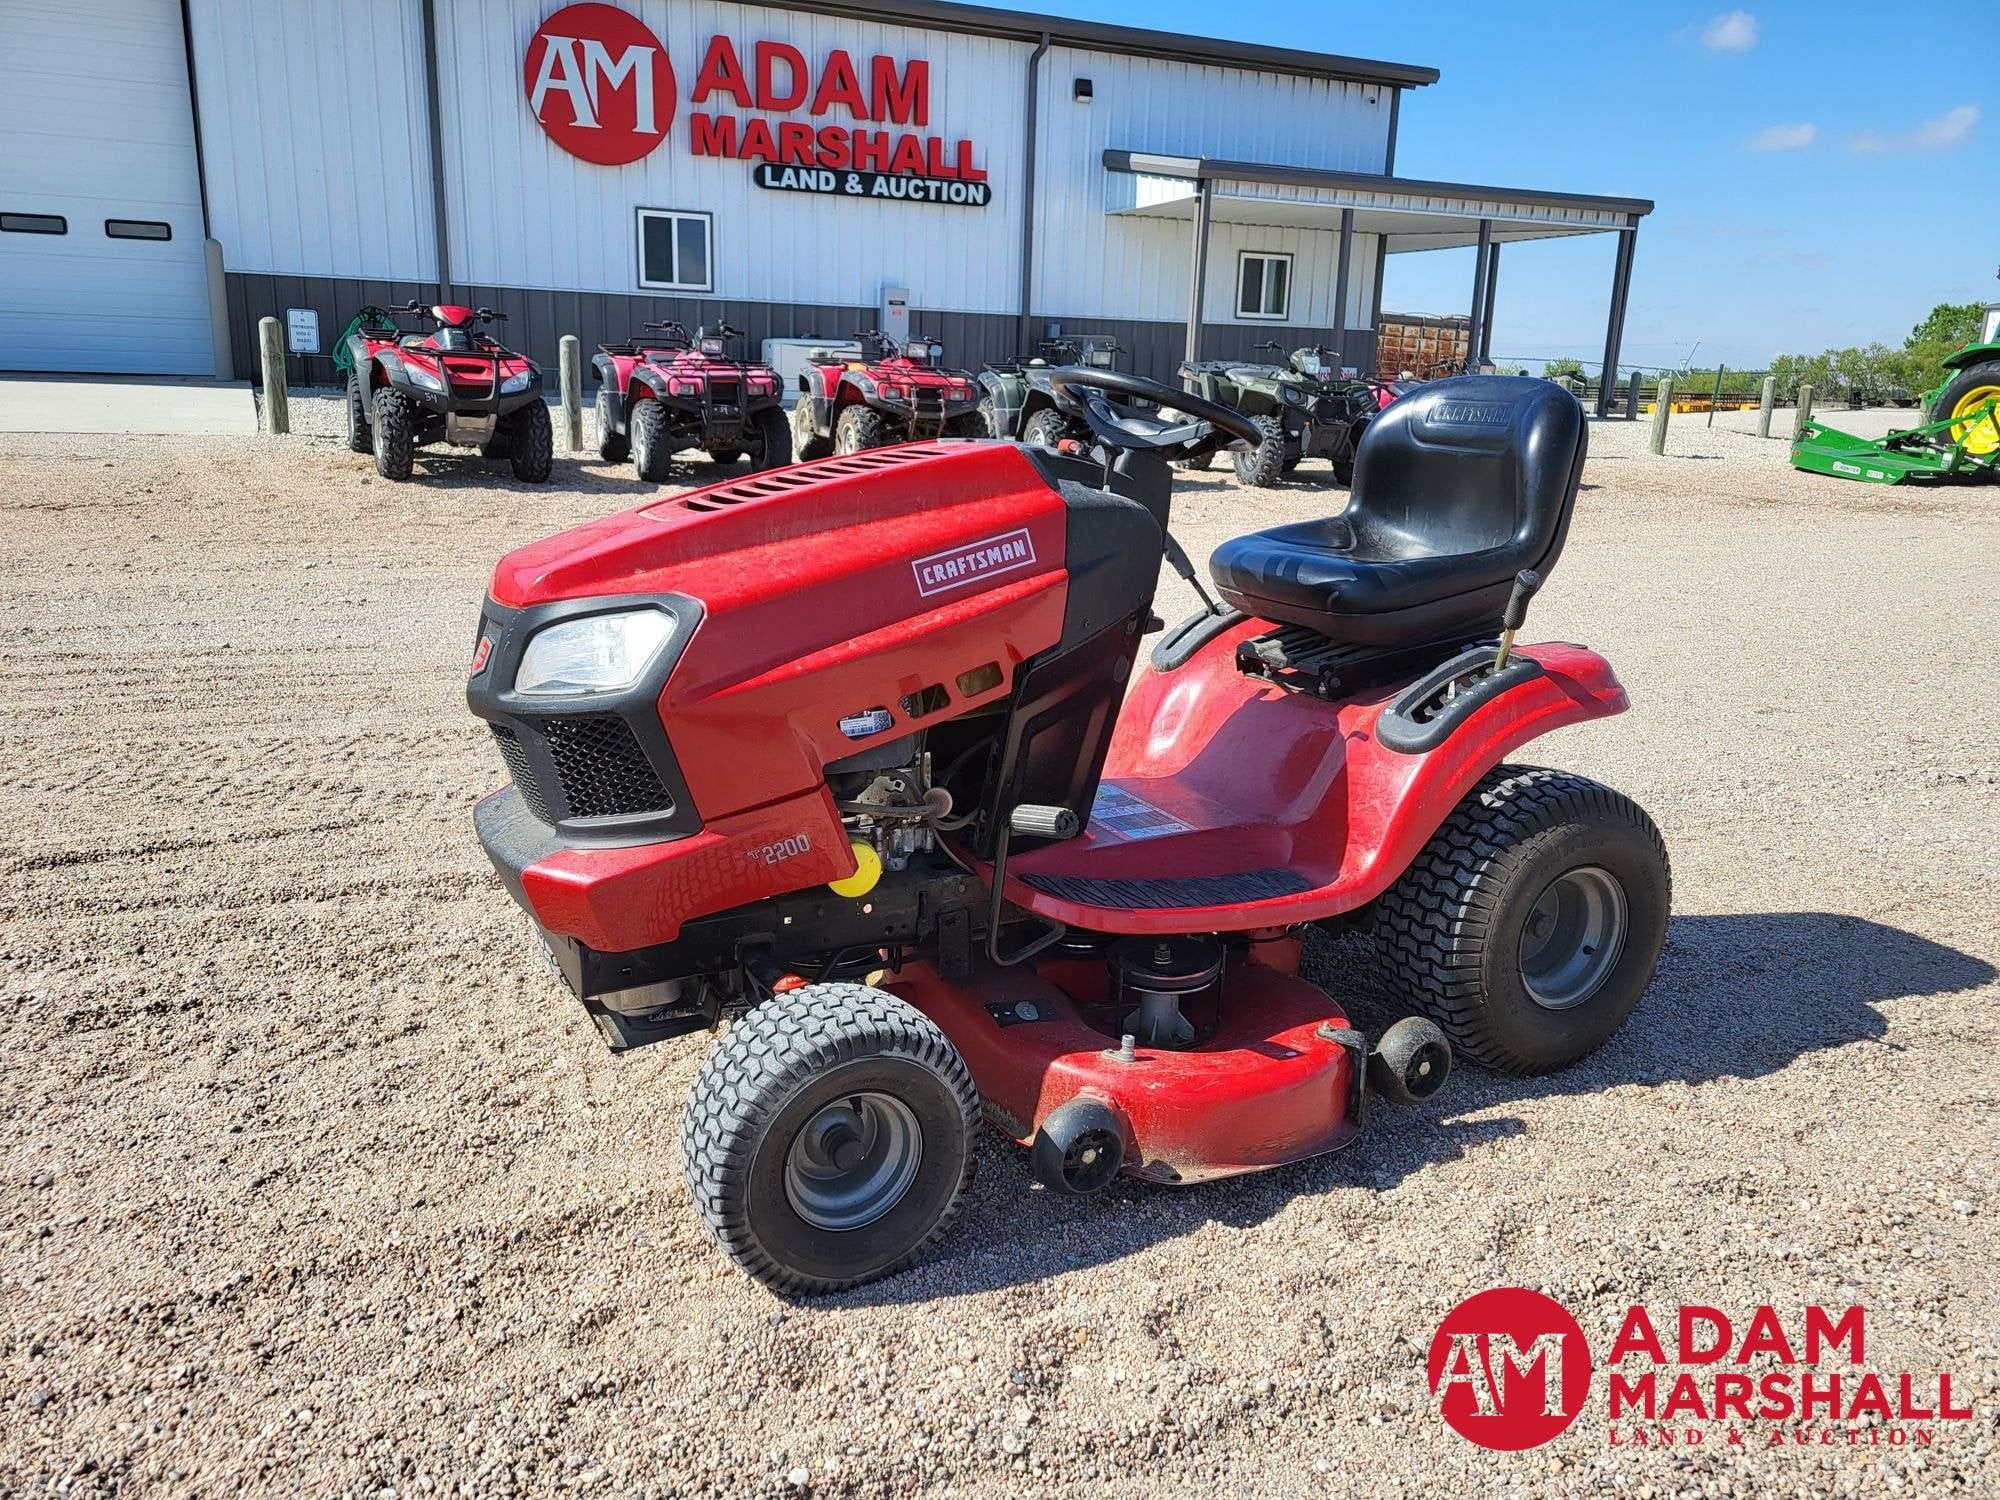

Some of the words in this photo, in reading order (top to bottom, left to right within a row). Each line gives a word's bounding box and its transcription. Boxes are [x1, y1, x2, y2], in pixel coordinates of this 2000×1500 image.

[530, 34, 660, 135] AM
[690, 34, 930, 127] ADAM
[690, 112, 988, 181] MARSHALL
[764, 167, 836, 194] LAND
[844, 174, 863, 195] &
[871, 177, 985, 205] AUCTION
[922, 539, 1027, 585] CRAFTSMAN
[746, 834, 810, 865] T2200
